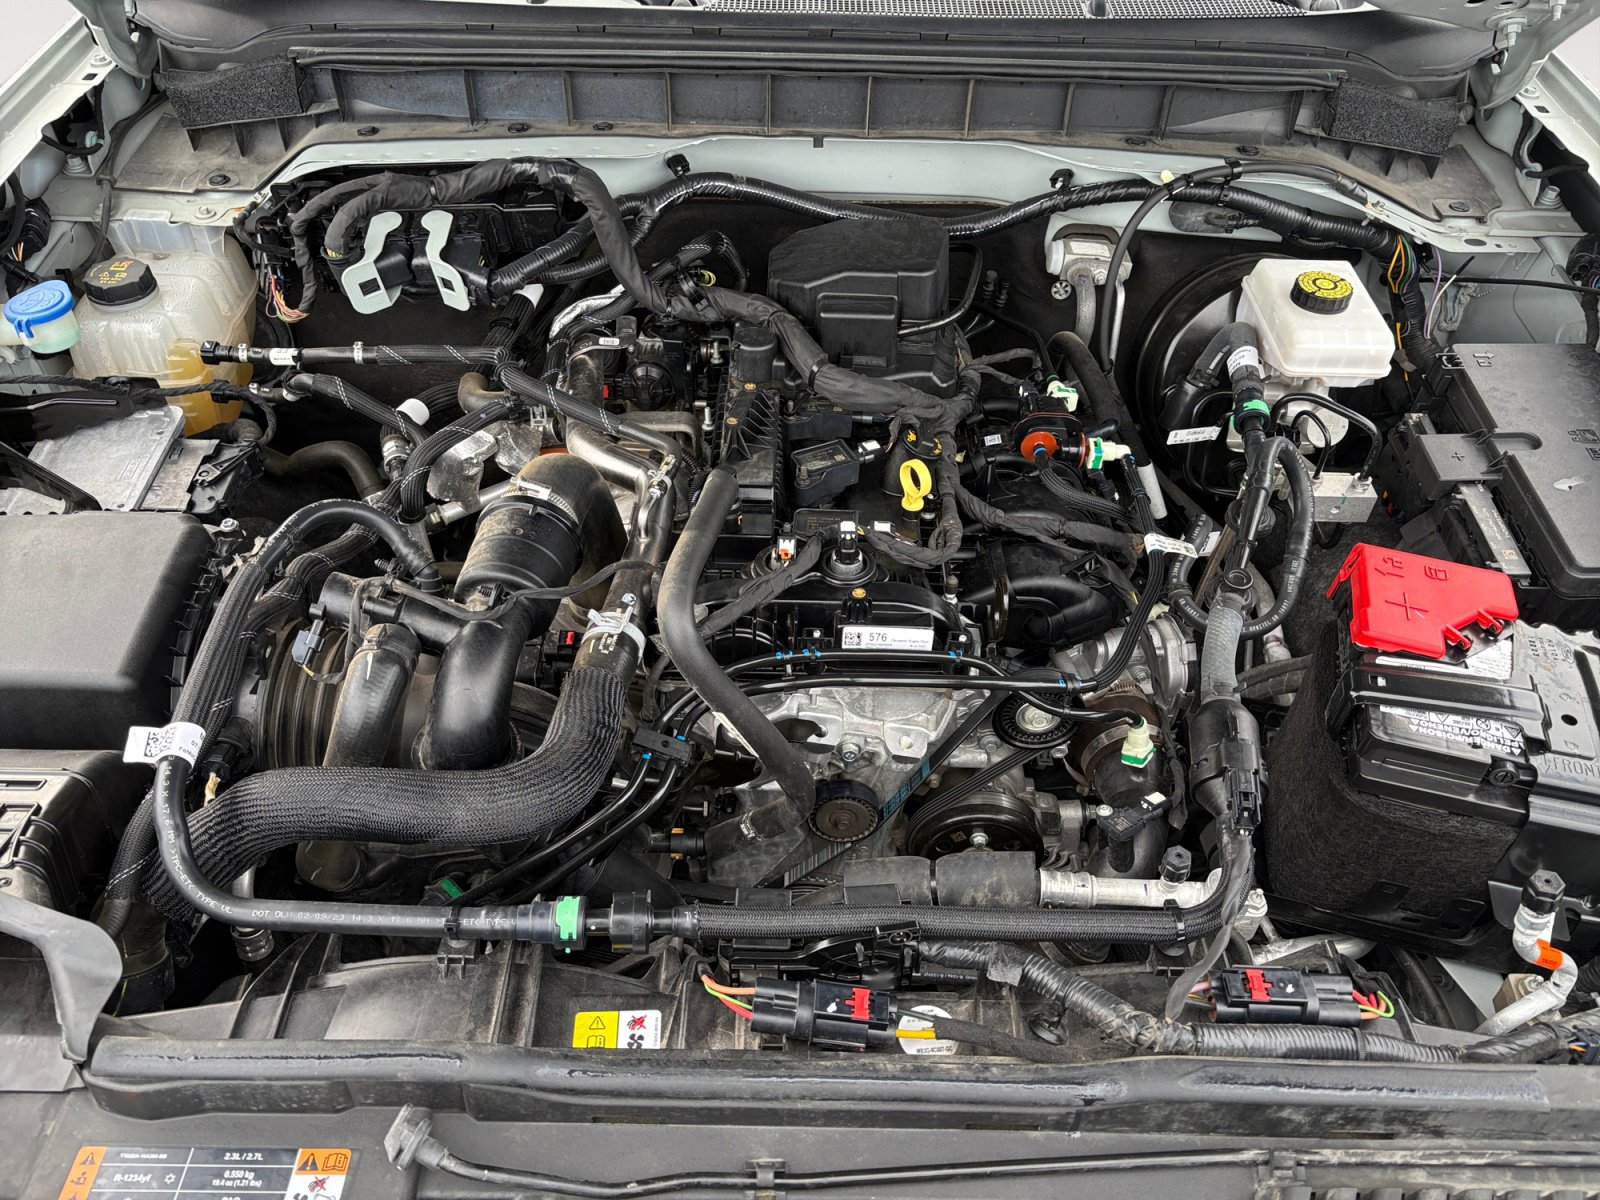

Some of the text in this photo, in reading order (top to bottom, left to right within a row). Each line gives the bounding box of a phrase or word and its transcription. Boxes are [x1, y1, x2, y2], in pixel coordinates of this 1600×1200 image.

[868, 632, 888, 642] 576
[196, 891, 217, 908] TYPE
[251, 909, 270, 918] DOT
[297, 911, 345, 921] 02/09/23
[223, 1152, 241, 1160] 2.3L
[246, 1152, 263, 1161] 2.7L
[113, 1173, 153, 1184] R-1234yf
[223, 1170, 255, 1180] 0.550 kg
